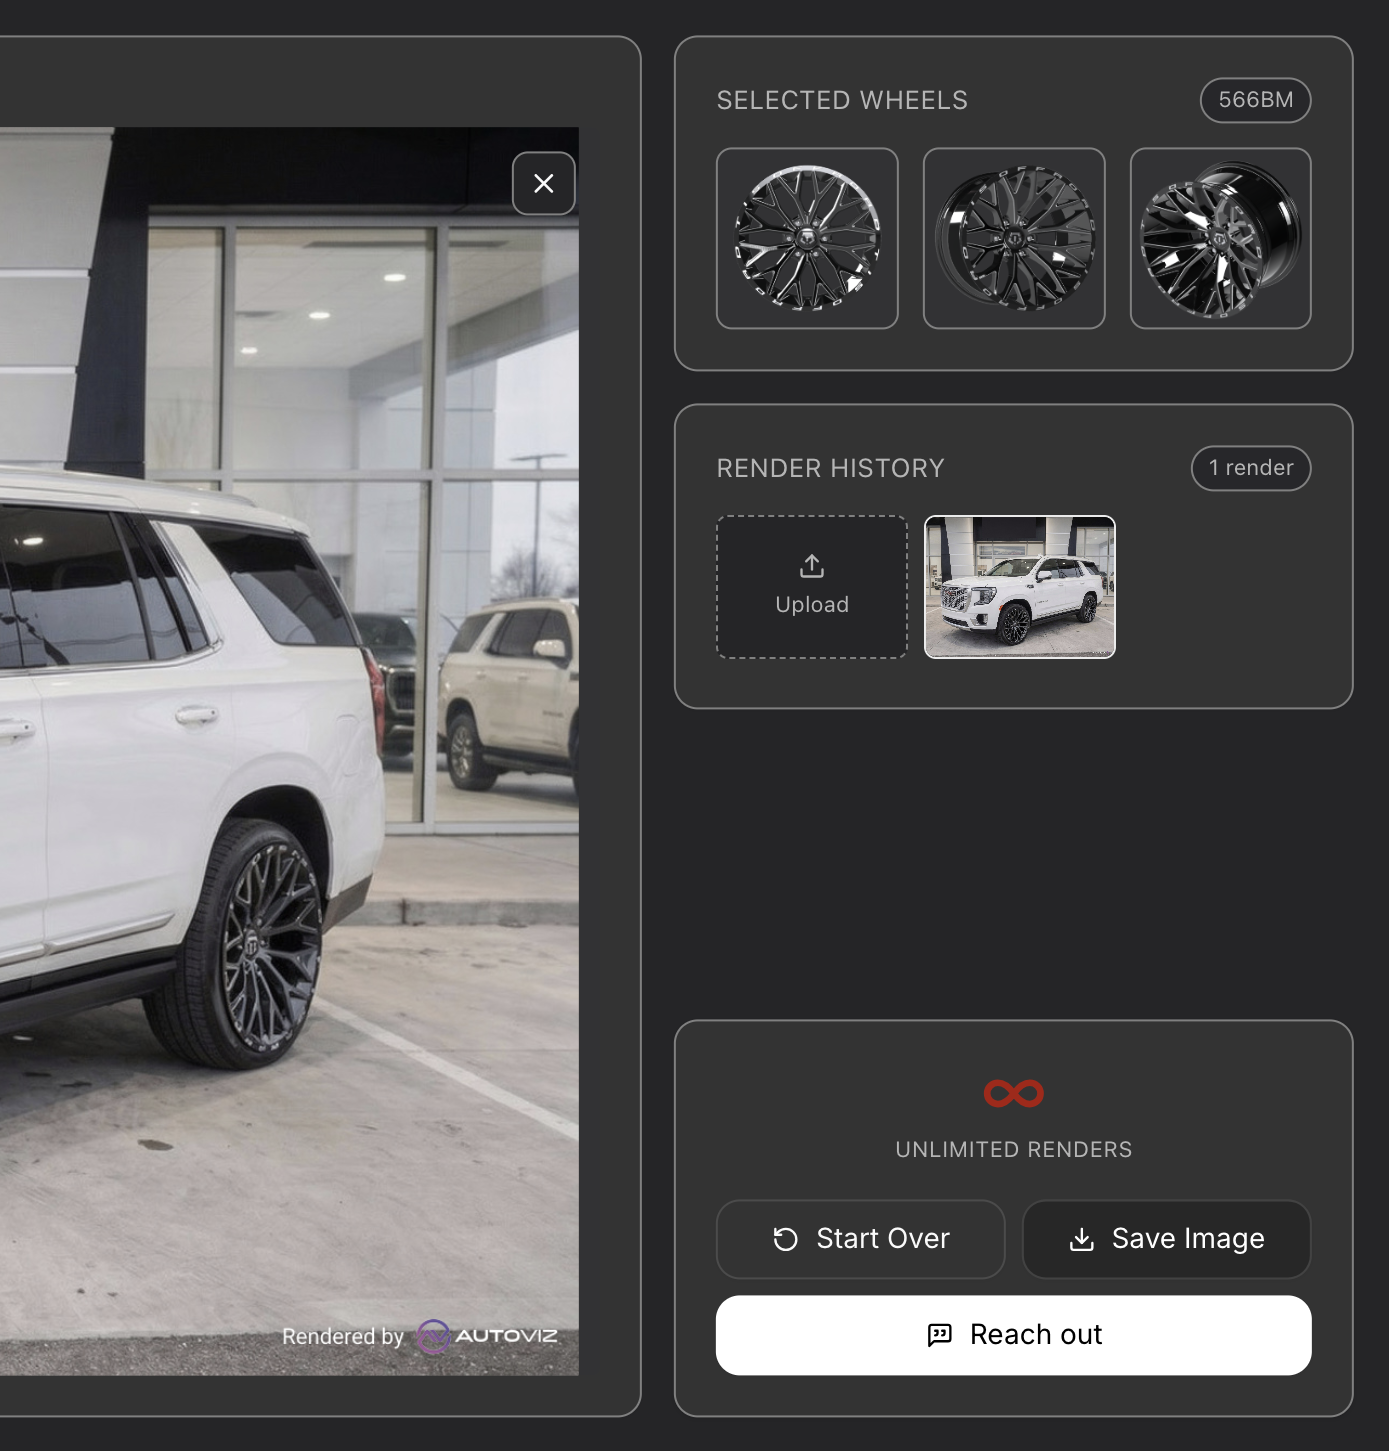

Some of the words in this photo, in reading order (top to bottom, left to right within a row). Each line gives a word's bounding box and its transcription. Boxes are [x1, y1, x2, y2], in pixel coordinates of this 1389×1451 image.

[717, 89, 850, 111] SELECTED
[859, 89, 968, 111] WHEELS
[1219, 90, 1293, 108] 566BM
[717, 457, 821, 478] RENDER
[831, 457, 945, 479] HISTORY
[1209, 458, 1217, 476] 1
[1226, 458, 1295, 476] render
[776, 595, 849, 617] Upload
[896, 1140, 1019, 1158] UNLIMITED
[1028, 1140, 1132, 1159] RENDERS
[817, 1226, 880, 1250] Start
[887, 1226, 951, 1250] Over
[1112, 1226, 1176, 1250] Save
[1185, 1226, 1265, 1255] Image
[971, 1322, 1051, 1346] Reach
[1060, 1324, 1103, 1346] out
